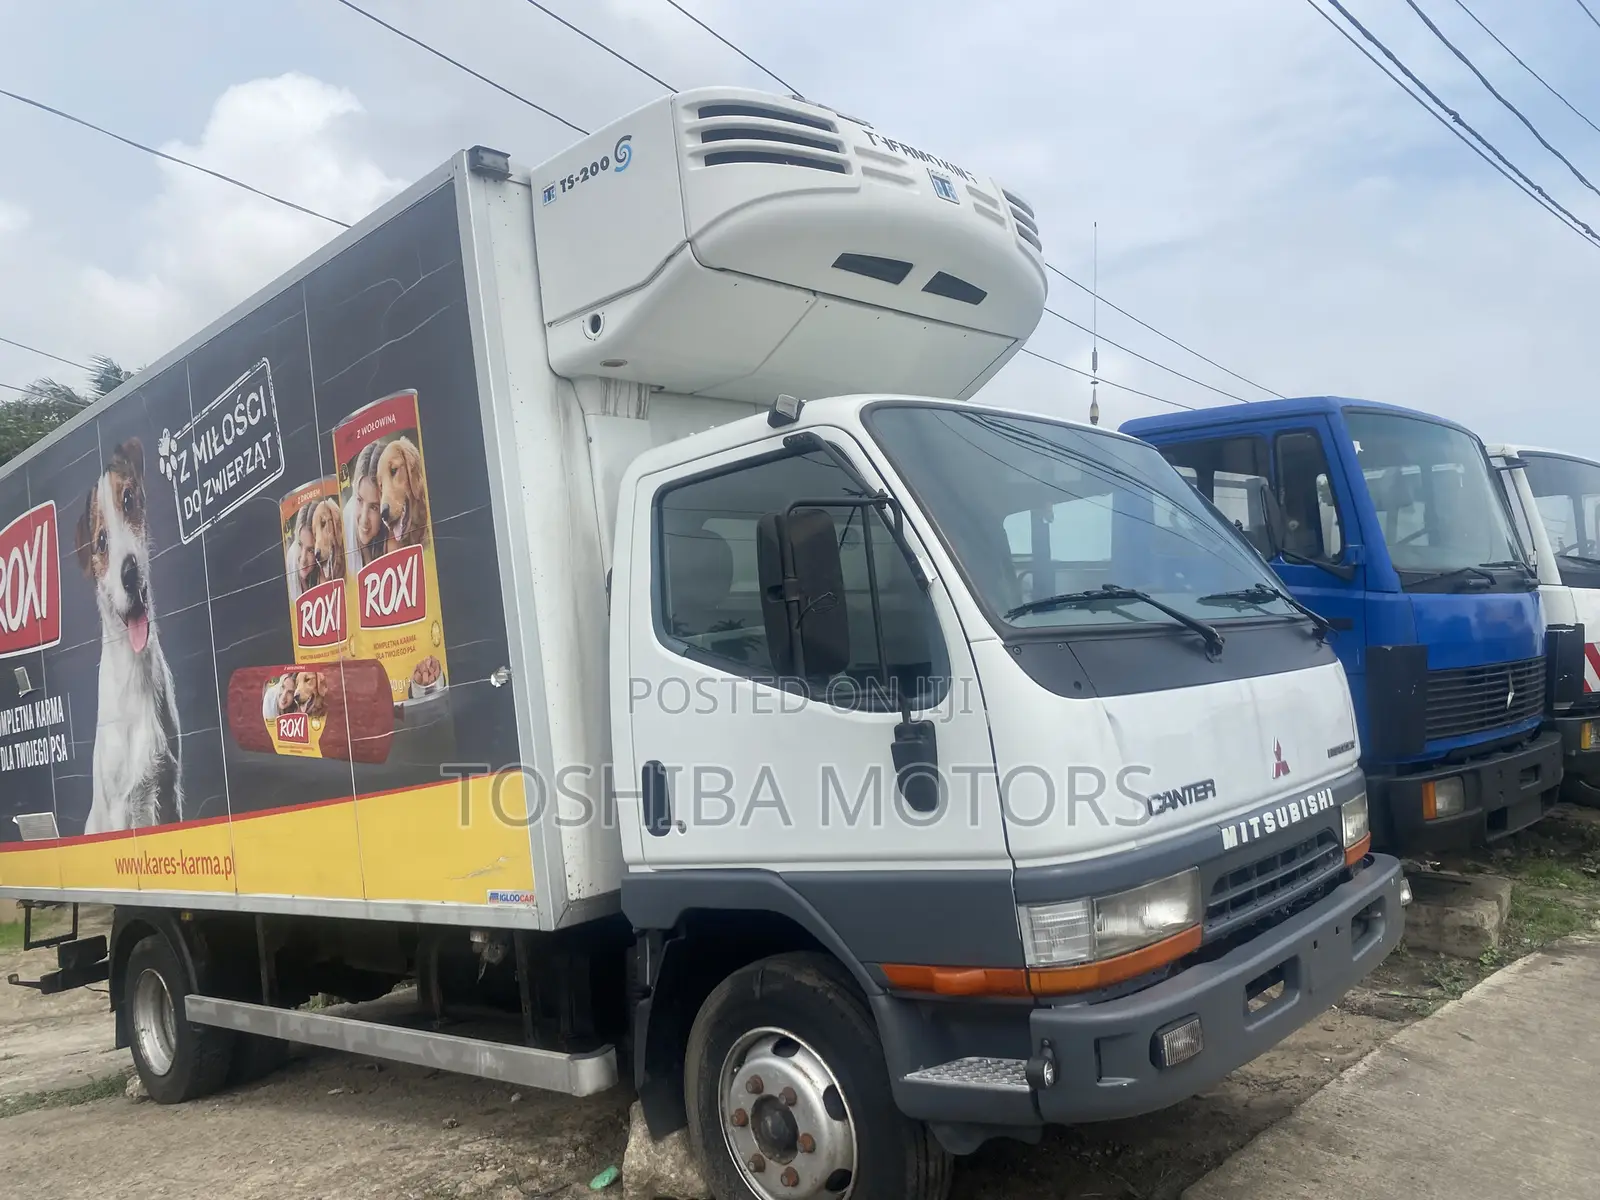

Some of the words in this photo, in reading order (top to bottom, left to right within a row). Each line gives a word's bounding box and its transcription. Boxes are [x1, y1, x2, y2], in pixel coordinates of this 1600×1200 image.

[560, 155, 610, 193] TS-200
[178, 450, 190, 484] Z
[192, 385, 267, 472] MIŁOŚCI
[356, 429, 361, 439] Z
[183, 489, 202, 520] DO
[203, 432, 272, 506] ZWIERZĄT
[364, 553, 418, 618] ROXI
[300, 586, 341, 638] ROXI
[0, 703, 35, 737] MPLETNA
[35, 695, 65, 728] KARMA
[280, 716, 305, 737] ROXI
[0, 745, 15, 772] DLA
[14, 737, 49, 769] TWOJEGO
[50, 734, 68, 763] PSA
[1147, 778, 1216, 816] CANTER
[1221, 788, 1334, 850] MITSUBISHI
[115, 849, 236, 880] www.kares-karma.pl
[499, 893, 535, 903] IGLOOCAR
